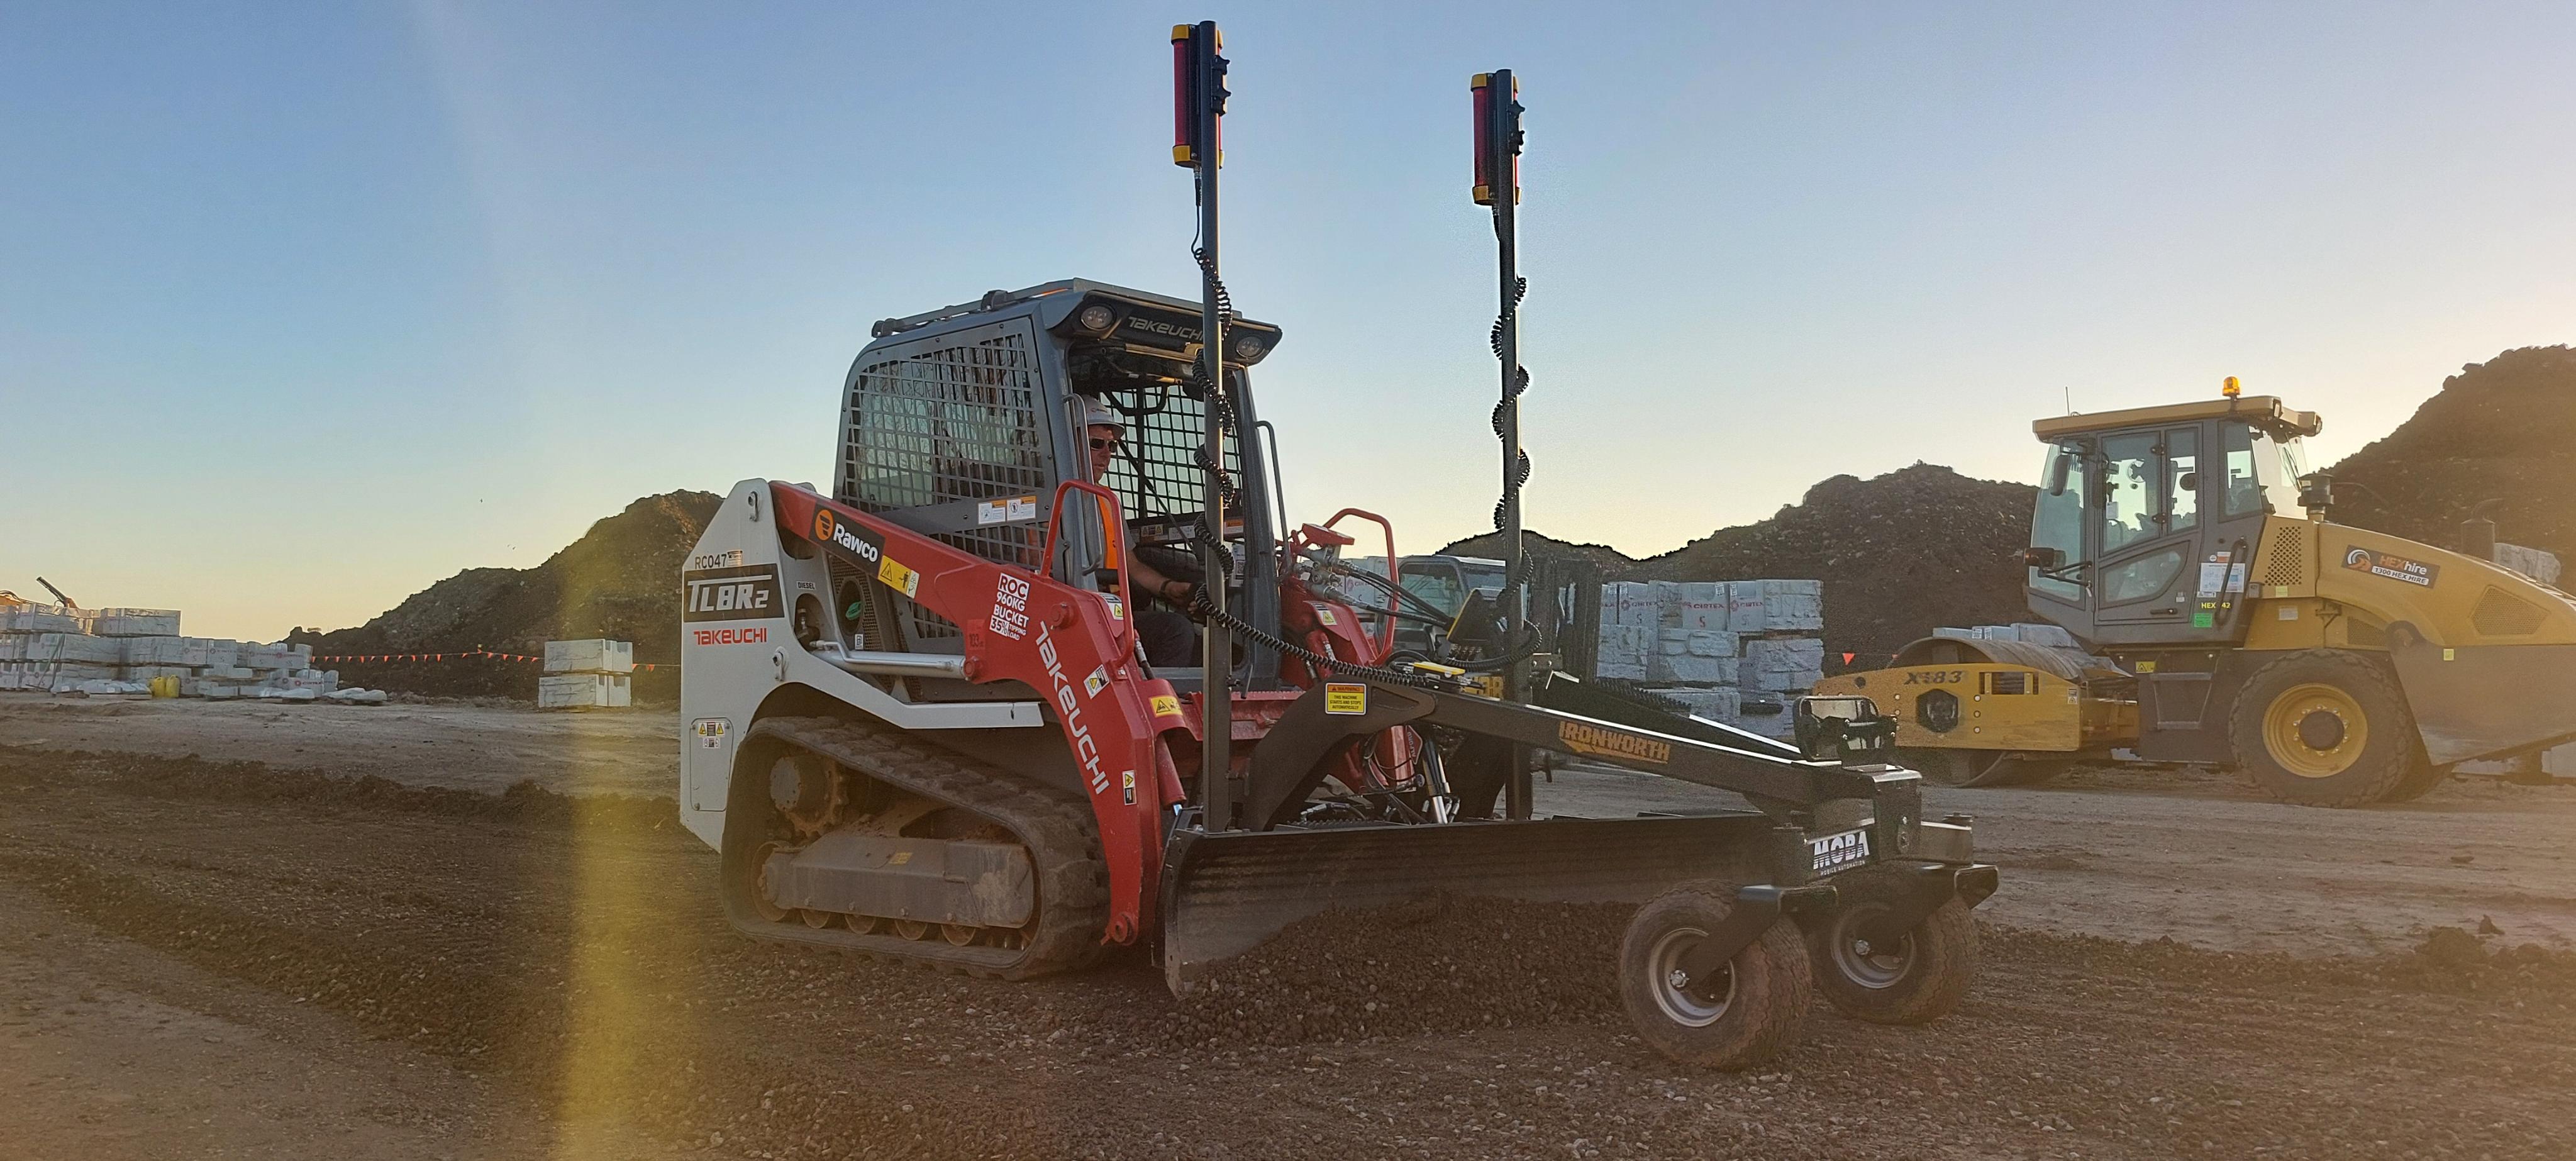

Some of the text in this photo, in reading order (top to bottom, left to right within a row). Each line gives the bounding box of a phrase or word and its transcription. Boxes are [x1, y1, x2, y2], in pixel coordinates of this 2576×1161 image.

[833, 523, 879, 563] Rawco
[999, 575, 1028, 598] ROC
[2375, 567, 2426, 584] 1300 HEX HIRE
[996, 591, 1026, 612] 960KG
[991, 617, 1008, 635] 35%
[994, 603, 1030, 628] BUCKET
[694, 628, 767, 645] TAKEUCHI
[1008, 630, 1020, 640] LOAD
[1036, 621, 1110, 795] TAKEUCHI
[1559, 721, 1671, 761] IRONWORTH
[1813, 831, 1870, 870] MOBA
[1838, 860, 1865, 871] AUTOMATION
